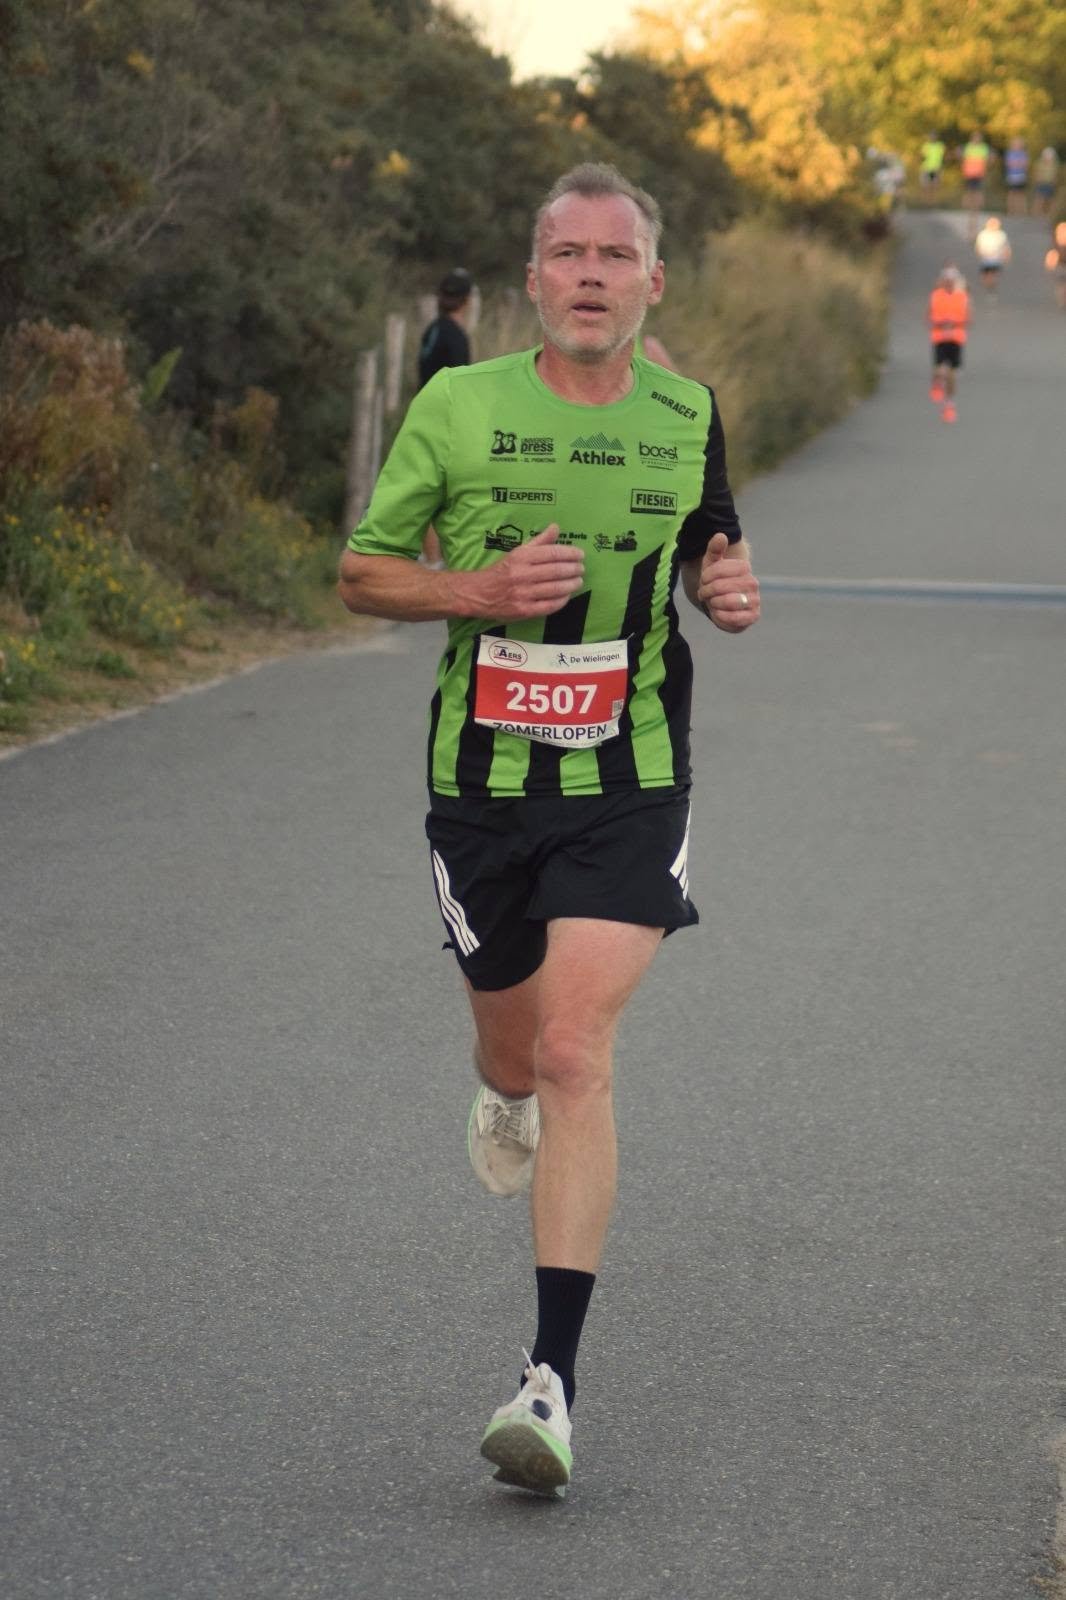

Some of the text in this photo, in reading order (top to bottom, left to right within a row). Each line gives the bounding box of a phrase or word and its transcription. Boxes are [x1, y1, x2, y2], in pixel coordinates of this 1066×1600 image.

[651, 391, 698, 421] BIORACER
[520, 443, 554, 454] press
[569, 450, 626, 466] Athlex
[509, 491, 553, 501] EXPERTS
[636, 493, 675, 508] FIESIEK
[499, 649, 522, 660] AERS
[570, 653, 620, 664] De Wielingen
[506, 681, 598, 715] 2507
